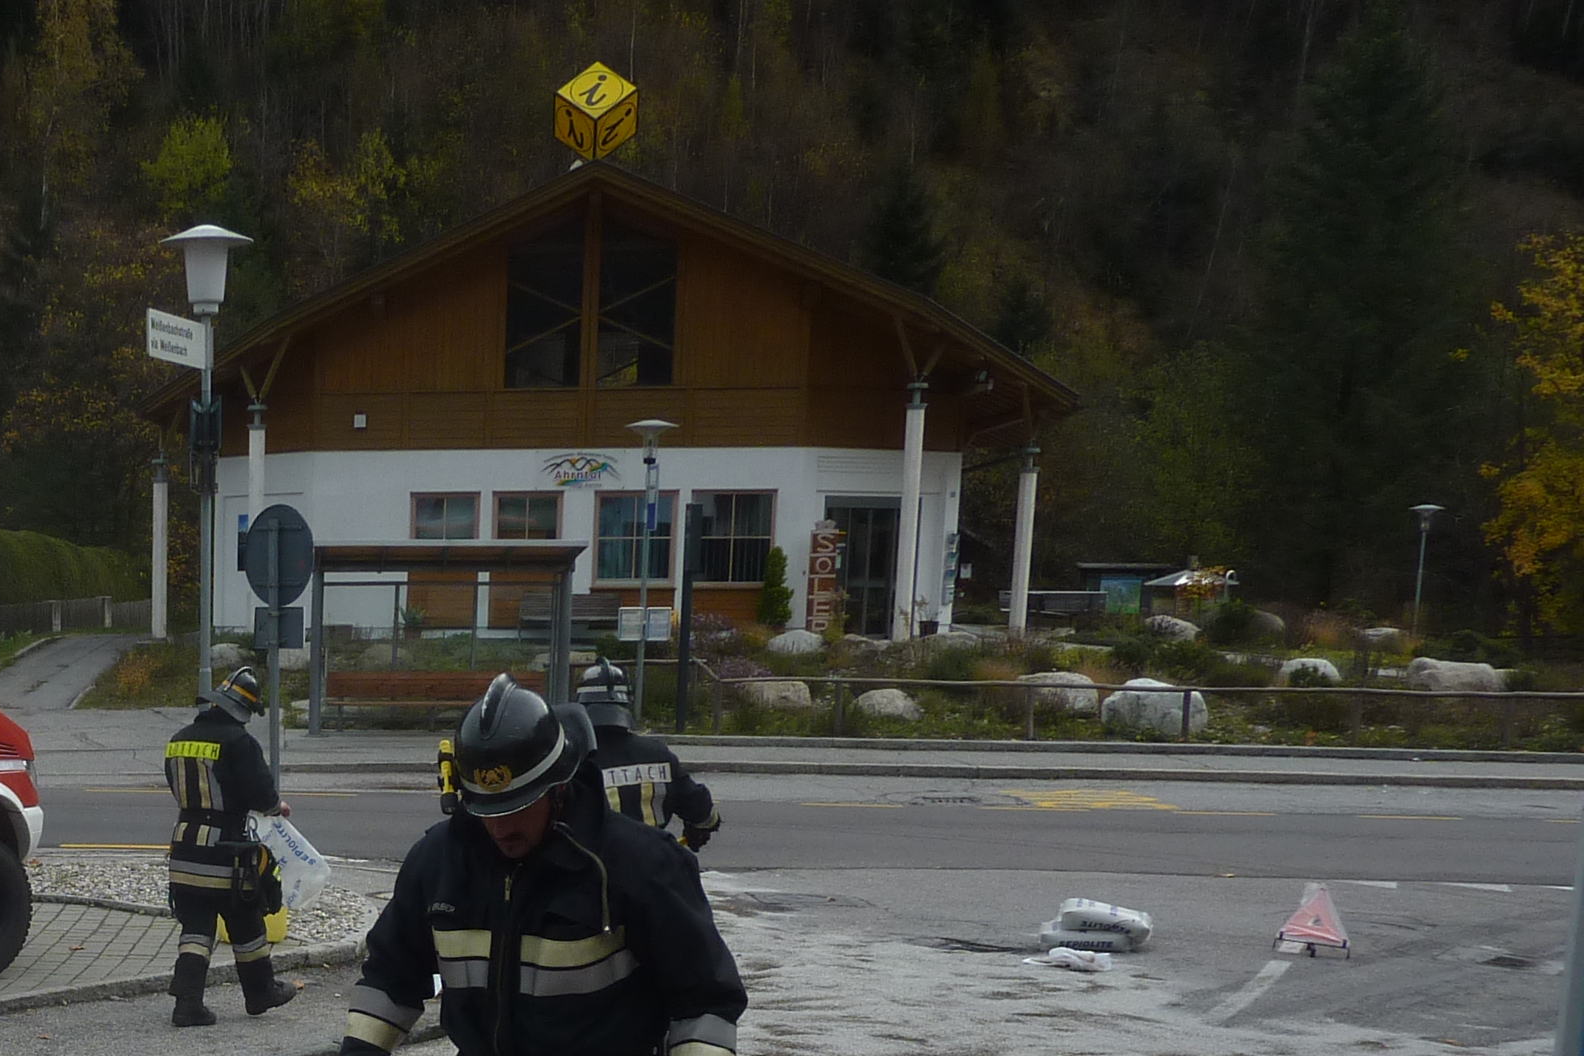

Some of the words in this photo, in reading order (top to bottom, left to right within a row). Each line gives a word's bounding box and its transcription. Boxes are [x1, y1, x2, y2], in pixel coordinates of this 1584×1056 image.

[554, 470, 603, 480] Ahrntal
[608, 766, 667, 785] TTACH
[273, 821, 316, 866] SEPIOLITE
[1058, 940, 1114, 949] SEPIOLITE
